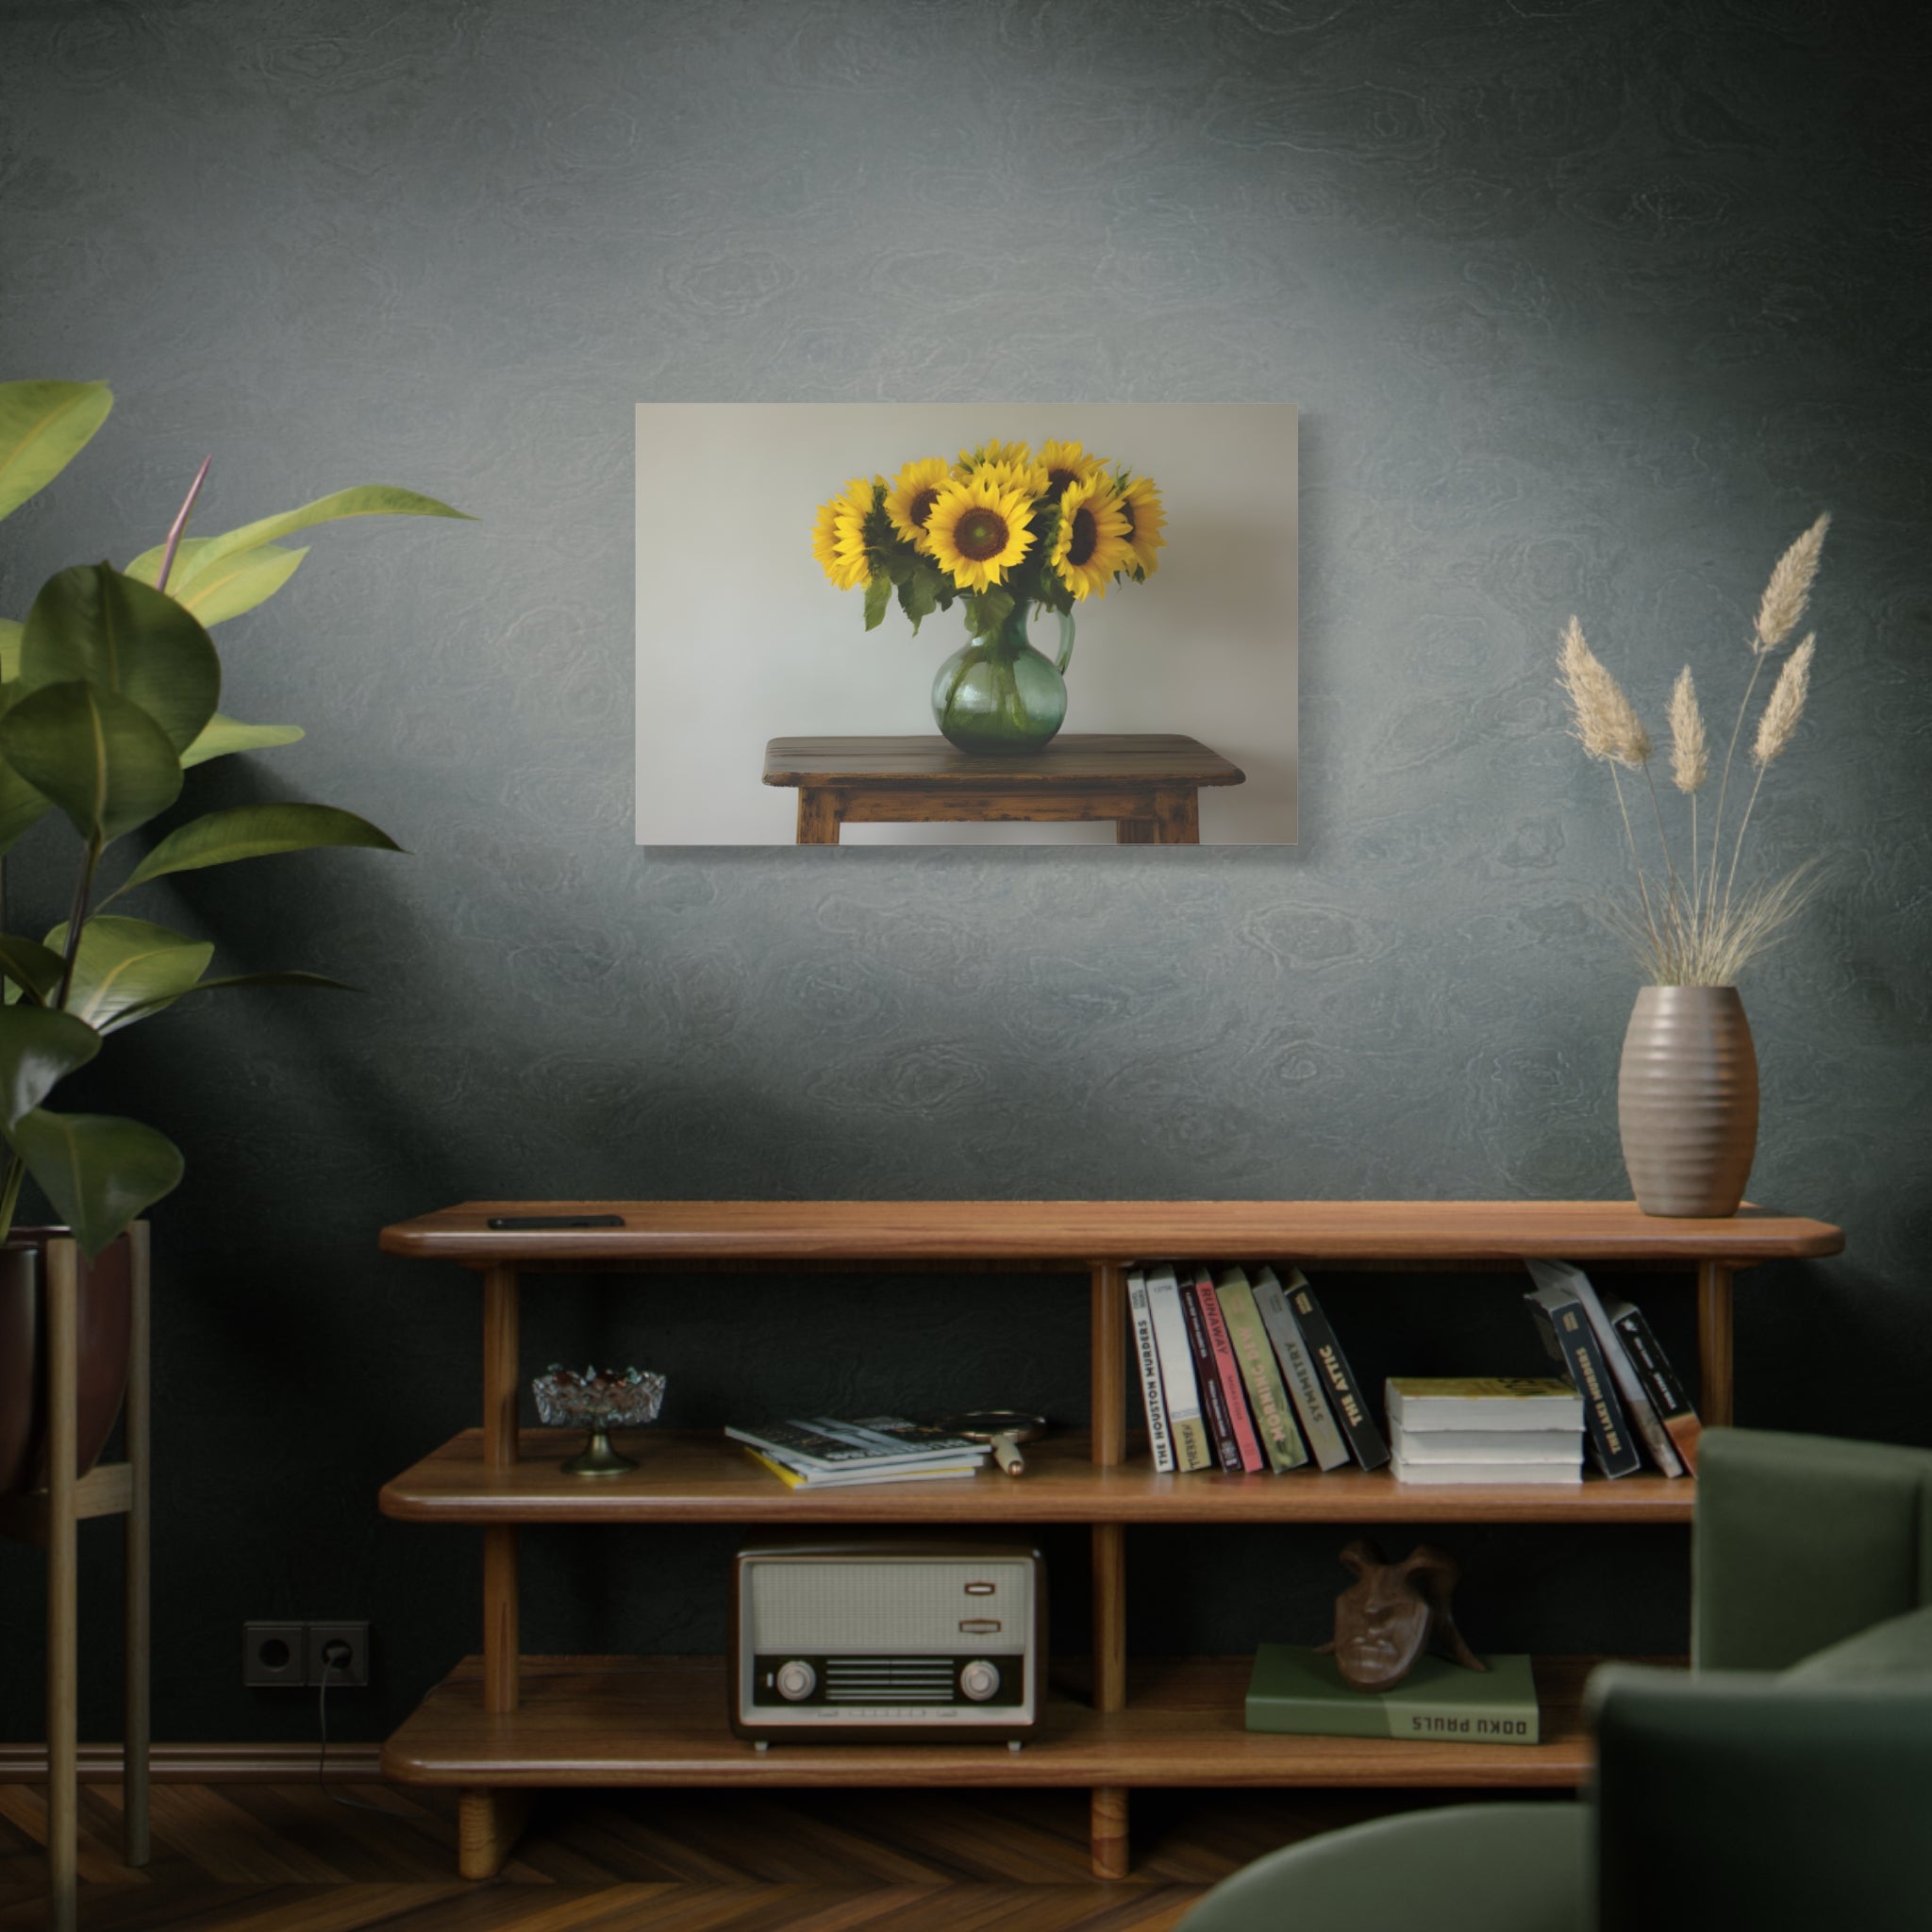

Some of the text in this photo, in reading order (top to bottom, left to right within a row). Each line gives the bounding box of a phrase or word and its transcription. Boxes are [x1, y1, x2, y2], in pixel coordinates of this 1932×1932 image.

[1200, 1287, 1228, 1355] RUNAWAY
[1138, 1319, 1170, 1467] THE HOUSTON MURDERS
[1251, 1364, 1287, 1441] MORNING
[1285, 1341, 1324, 1424] SYMMETRY
[1318, 1344, 1363, 1427] THE ATTIC
[1575, 1346, 1623, 1455] THE LAKE MURDERS
[1411, 1716, 1527, 1735] DOKU PAULS
